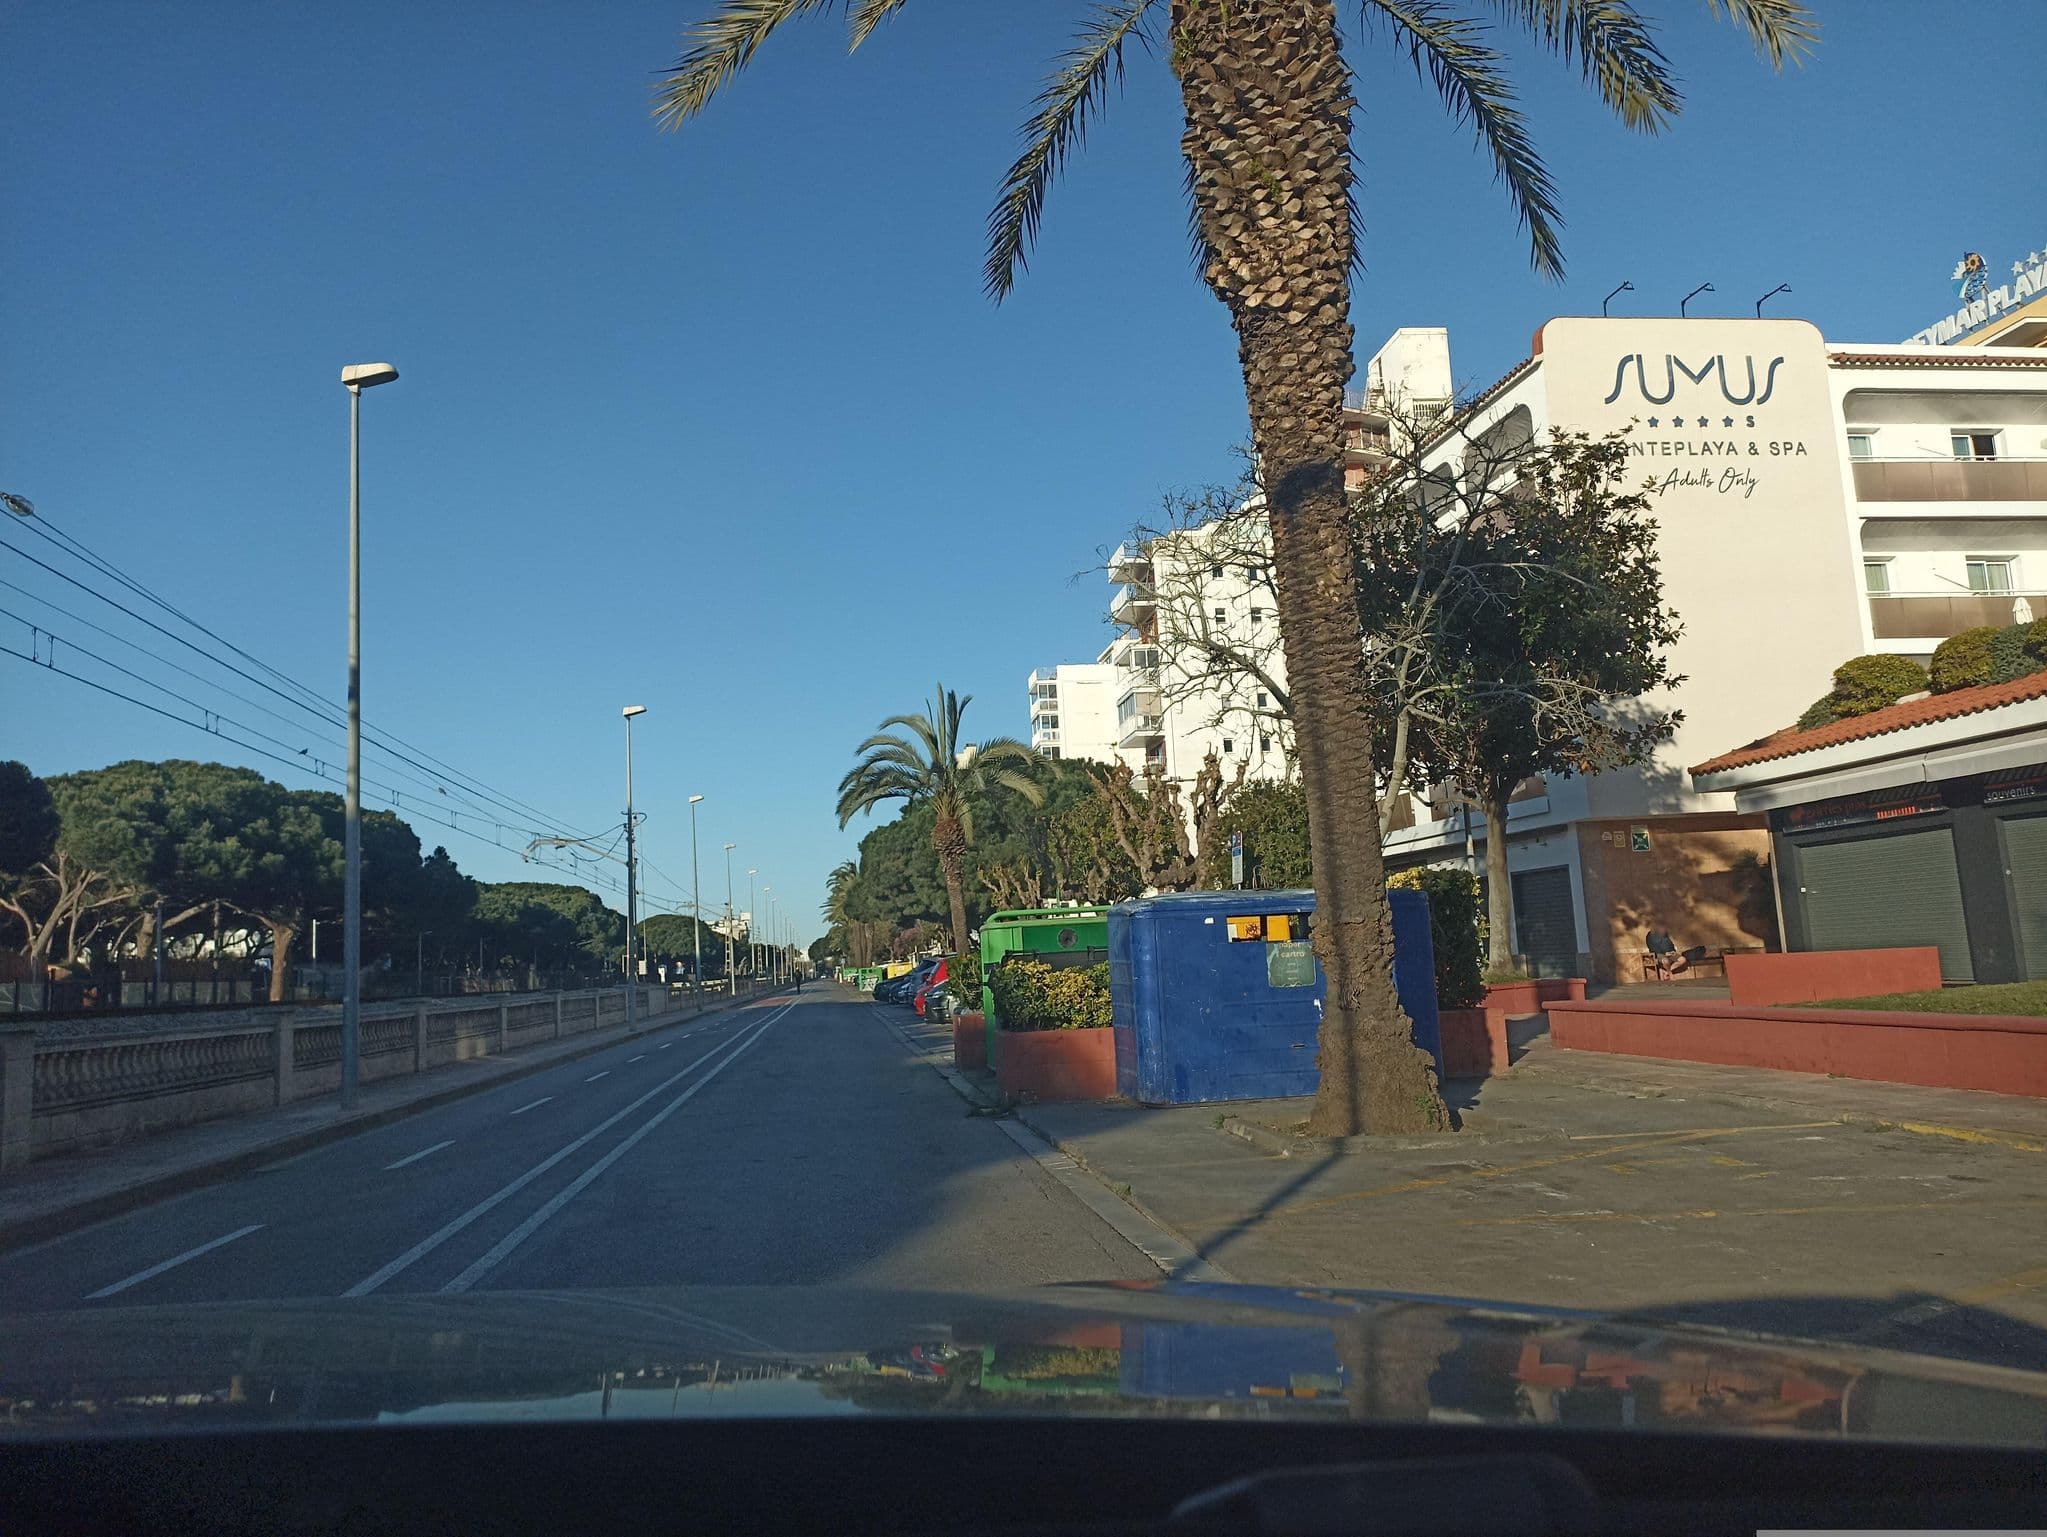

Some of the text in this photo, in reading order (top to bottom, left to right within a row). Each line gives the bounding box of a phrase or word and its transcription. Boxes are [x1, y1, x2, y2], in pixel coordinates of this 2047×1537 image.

[1604, 354, 1784, 406] SUMUS
[1622, 440, 1808, 457] NTEPLAYA & SPA
[1659, 466, 1760, 498] Adults Only
